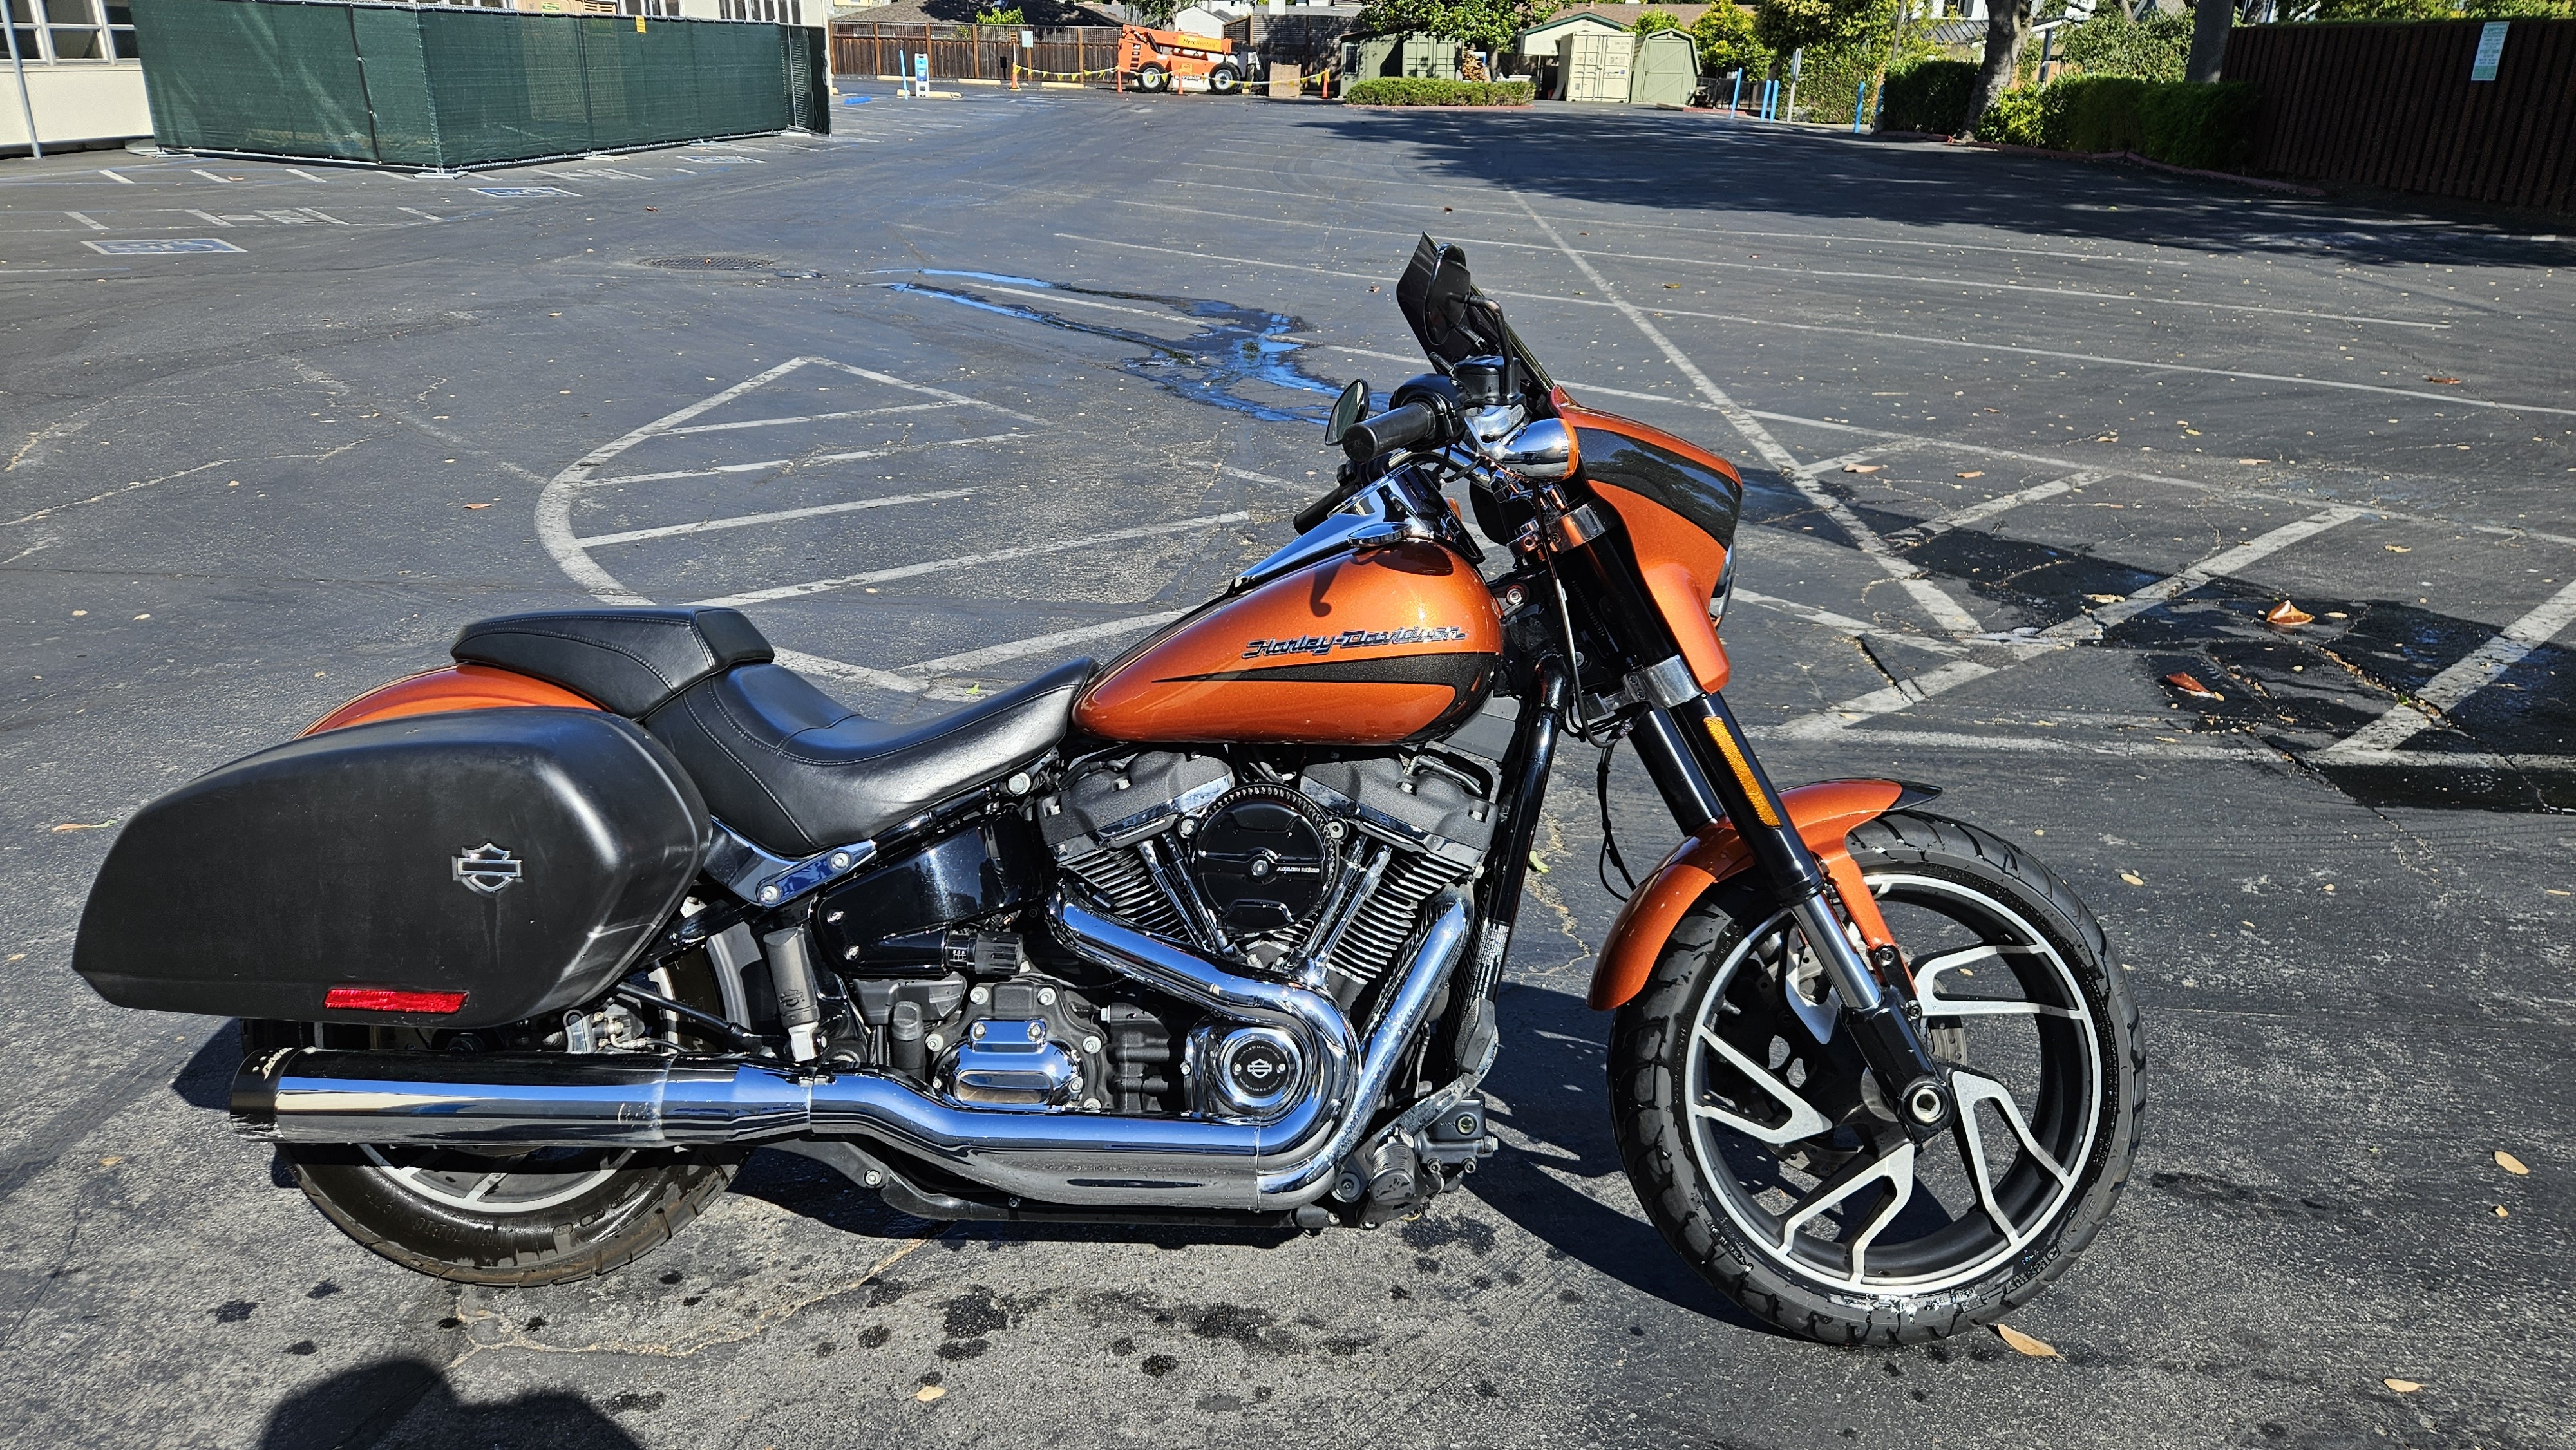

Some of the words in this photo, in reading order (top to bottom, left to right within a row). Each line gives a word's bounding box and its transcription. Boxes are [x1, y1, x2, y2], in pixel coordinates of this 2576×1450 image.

[1241, 626, 1468, 659] Harley-Davidson
[1238, 1045, 1280, 1060] HARLEY-DAVIDSON
[1239, 1077, 1281, 1091] MILWAUKEE-EIGHT
